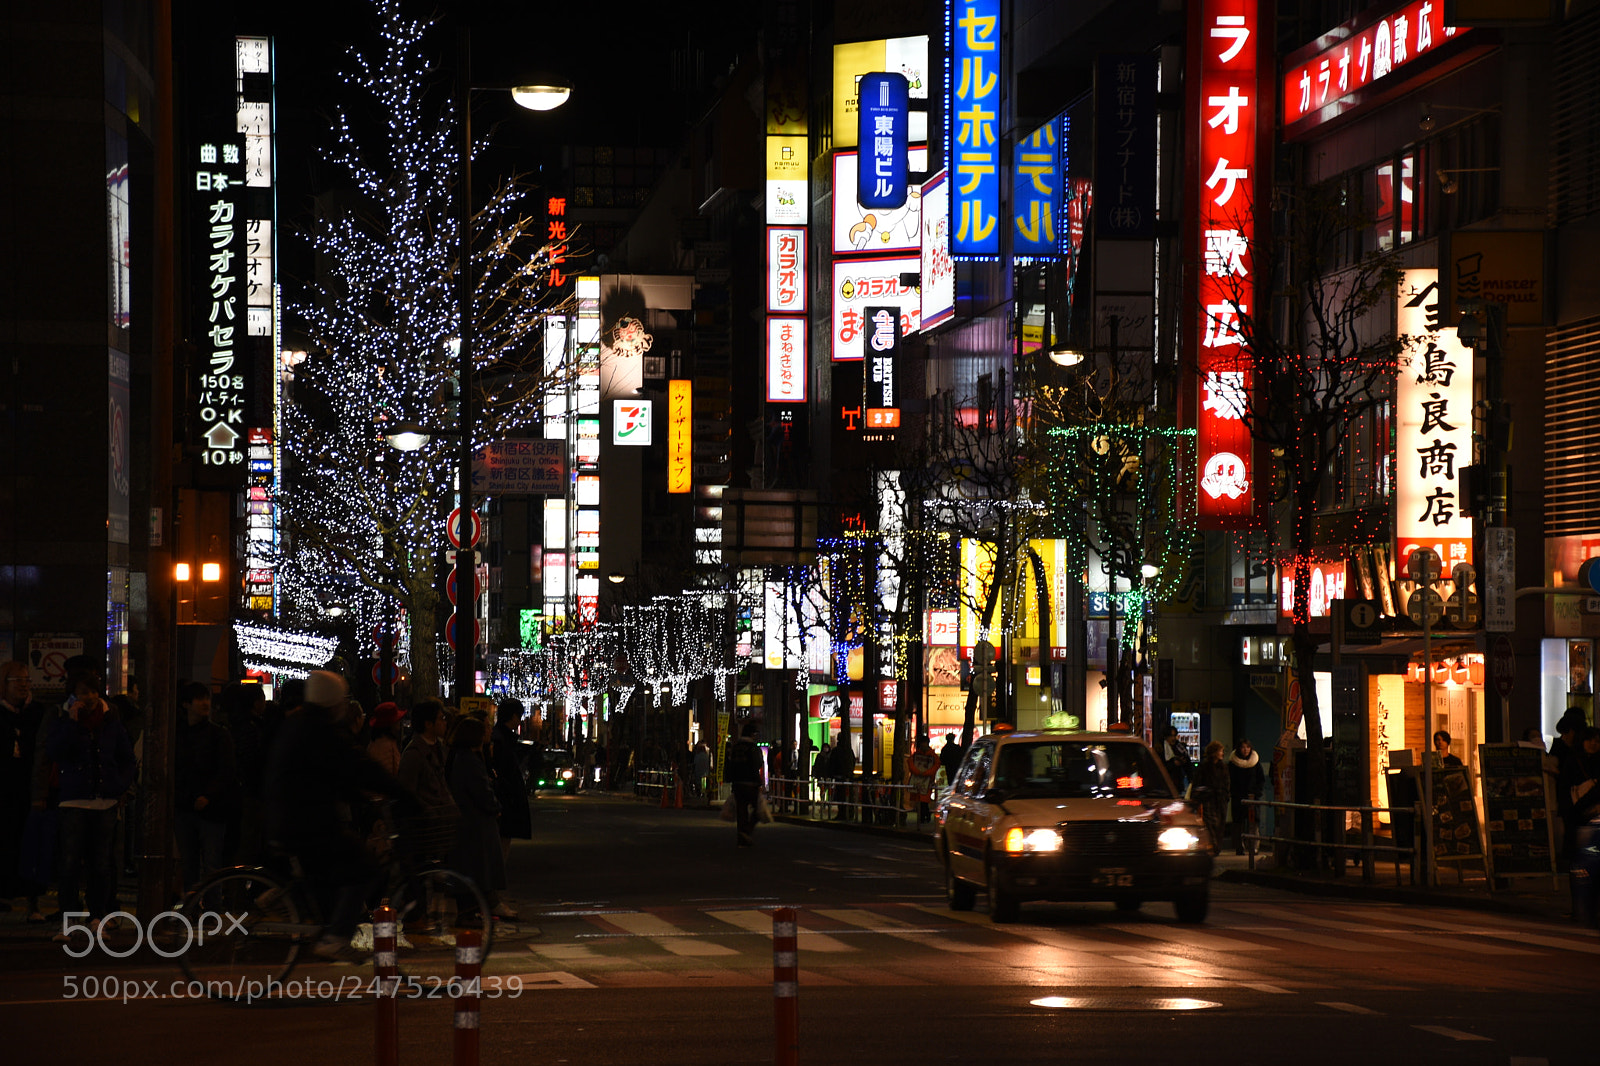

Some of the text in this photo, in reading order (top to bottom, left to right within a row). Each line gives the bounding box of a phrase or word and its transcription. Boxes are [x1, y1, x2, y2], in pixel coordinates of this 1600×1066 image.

[1300, 37, 1371, 113] カラオケ
[956, 8, 998, 242] セルホテル
[200, 144, 240, 164] 曲数
[874, 115, 894, 198] 東陽ビル
[196, 171, 244, 192] 日本一
[1203, 16, 1250, 420] ラオケ歌広場
[548, 197, 567, 287] 新光ビル
[779, 236, 796, 304] カラオケ
[208, 199, 236, 375] カラオケパセラ
[780, 323, 793, 395] まねきねこ
[873, 357, 883, 382] PUB
[200, 374, 244, 390] 150名
[874, 412, 894, 424] 2F
[201, 450, 244, 465] 10秒
[490, 442, 560, 456] 新宿区役所
[490, 456, 559, 465] Shinjuku City Office
[490, 467, 560, 481] 新宿区議会
[489, 482, 560, 491] Shinjuku City Assembly
[936, 700, 960, 711] Zirco
